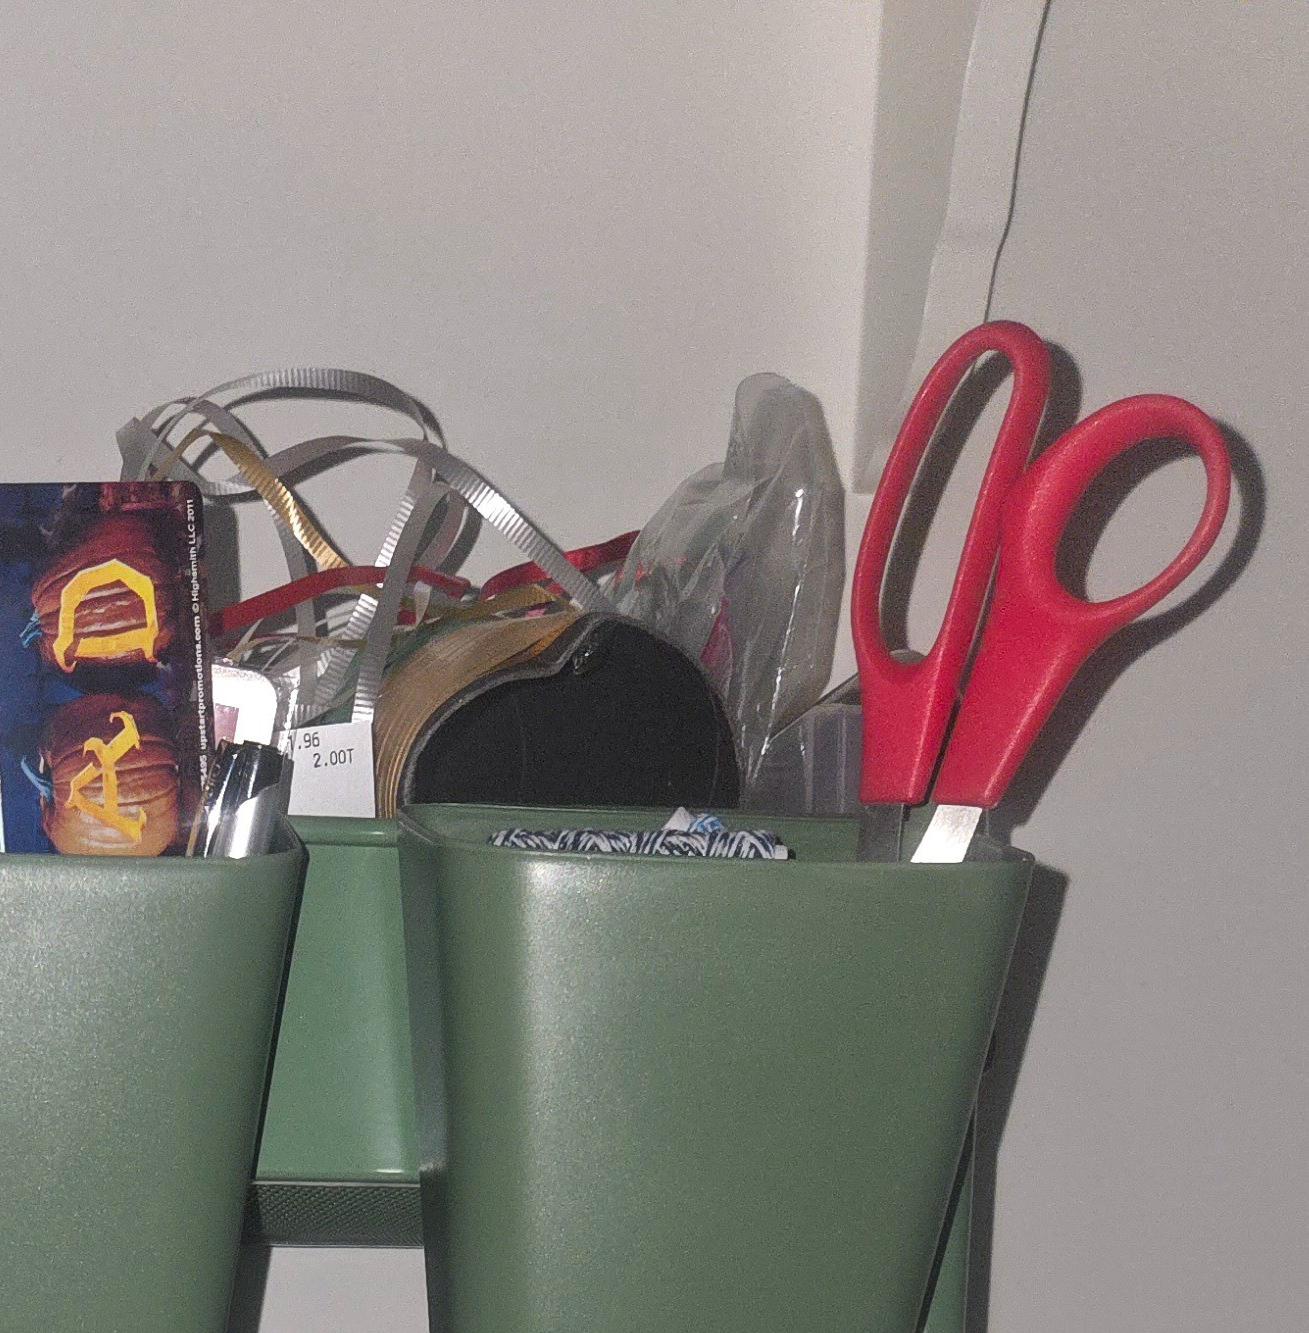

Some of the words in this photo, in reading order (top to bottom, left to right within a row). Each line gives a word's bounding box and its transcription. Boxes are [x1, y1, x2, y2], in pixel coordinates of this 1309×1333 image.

[186, 499, 195, 522] 2011
[187, 524, 196, 544] LLC
[189, 547, 201, 601] Highsmith
[192, 616, 208, 749] upstartpromotions.com
[313, 749, 354, 768] 2.00T
